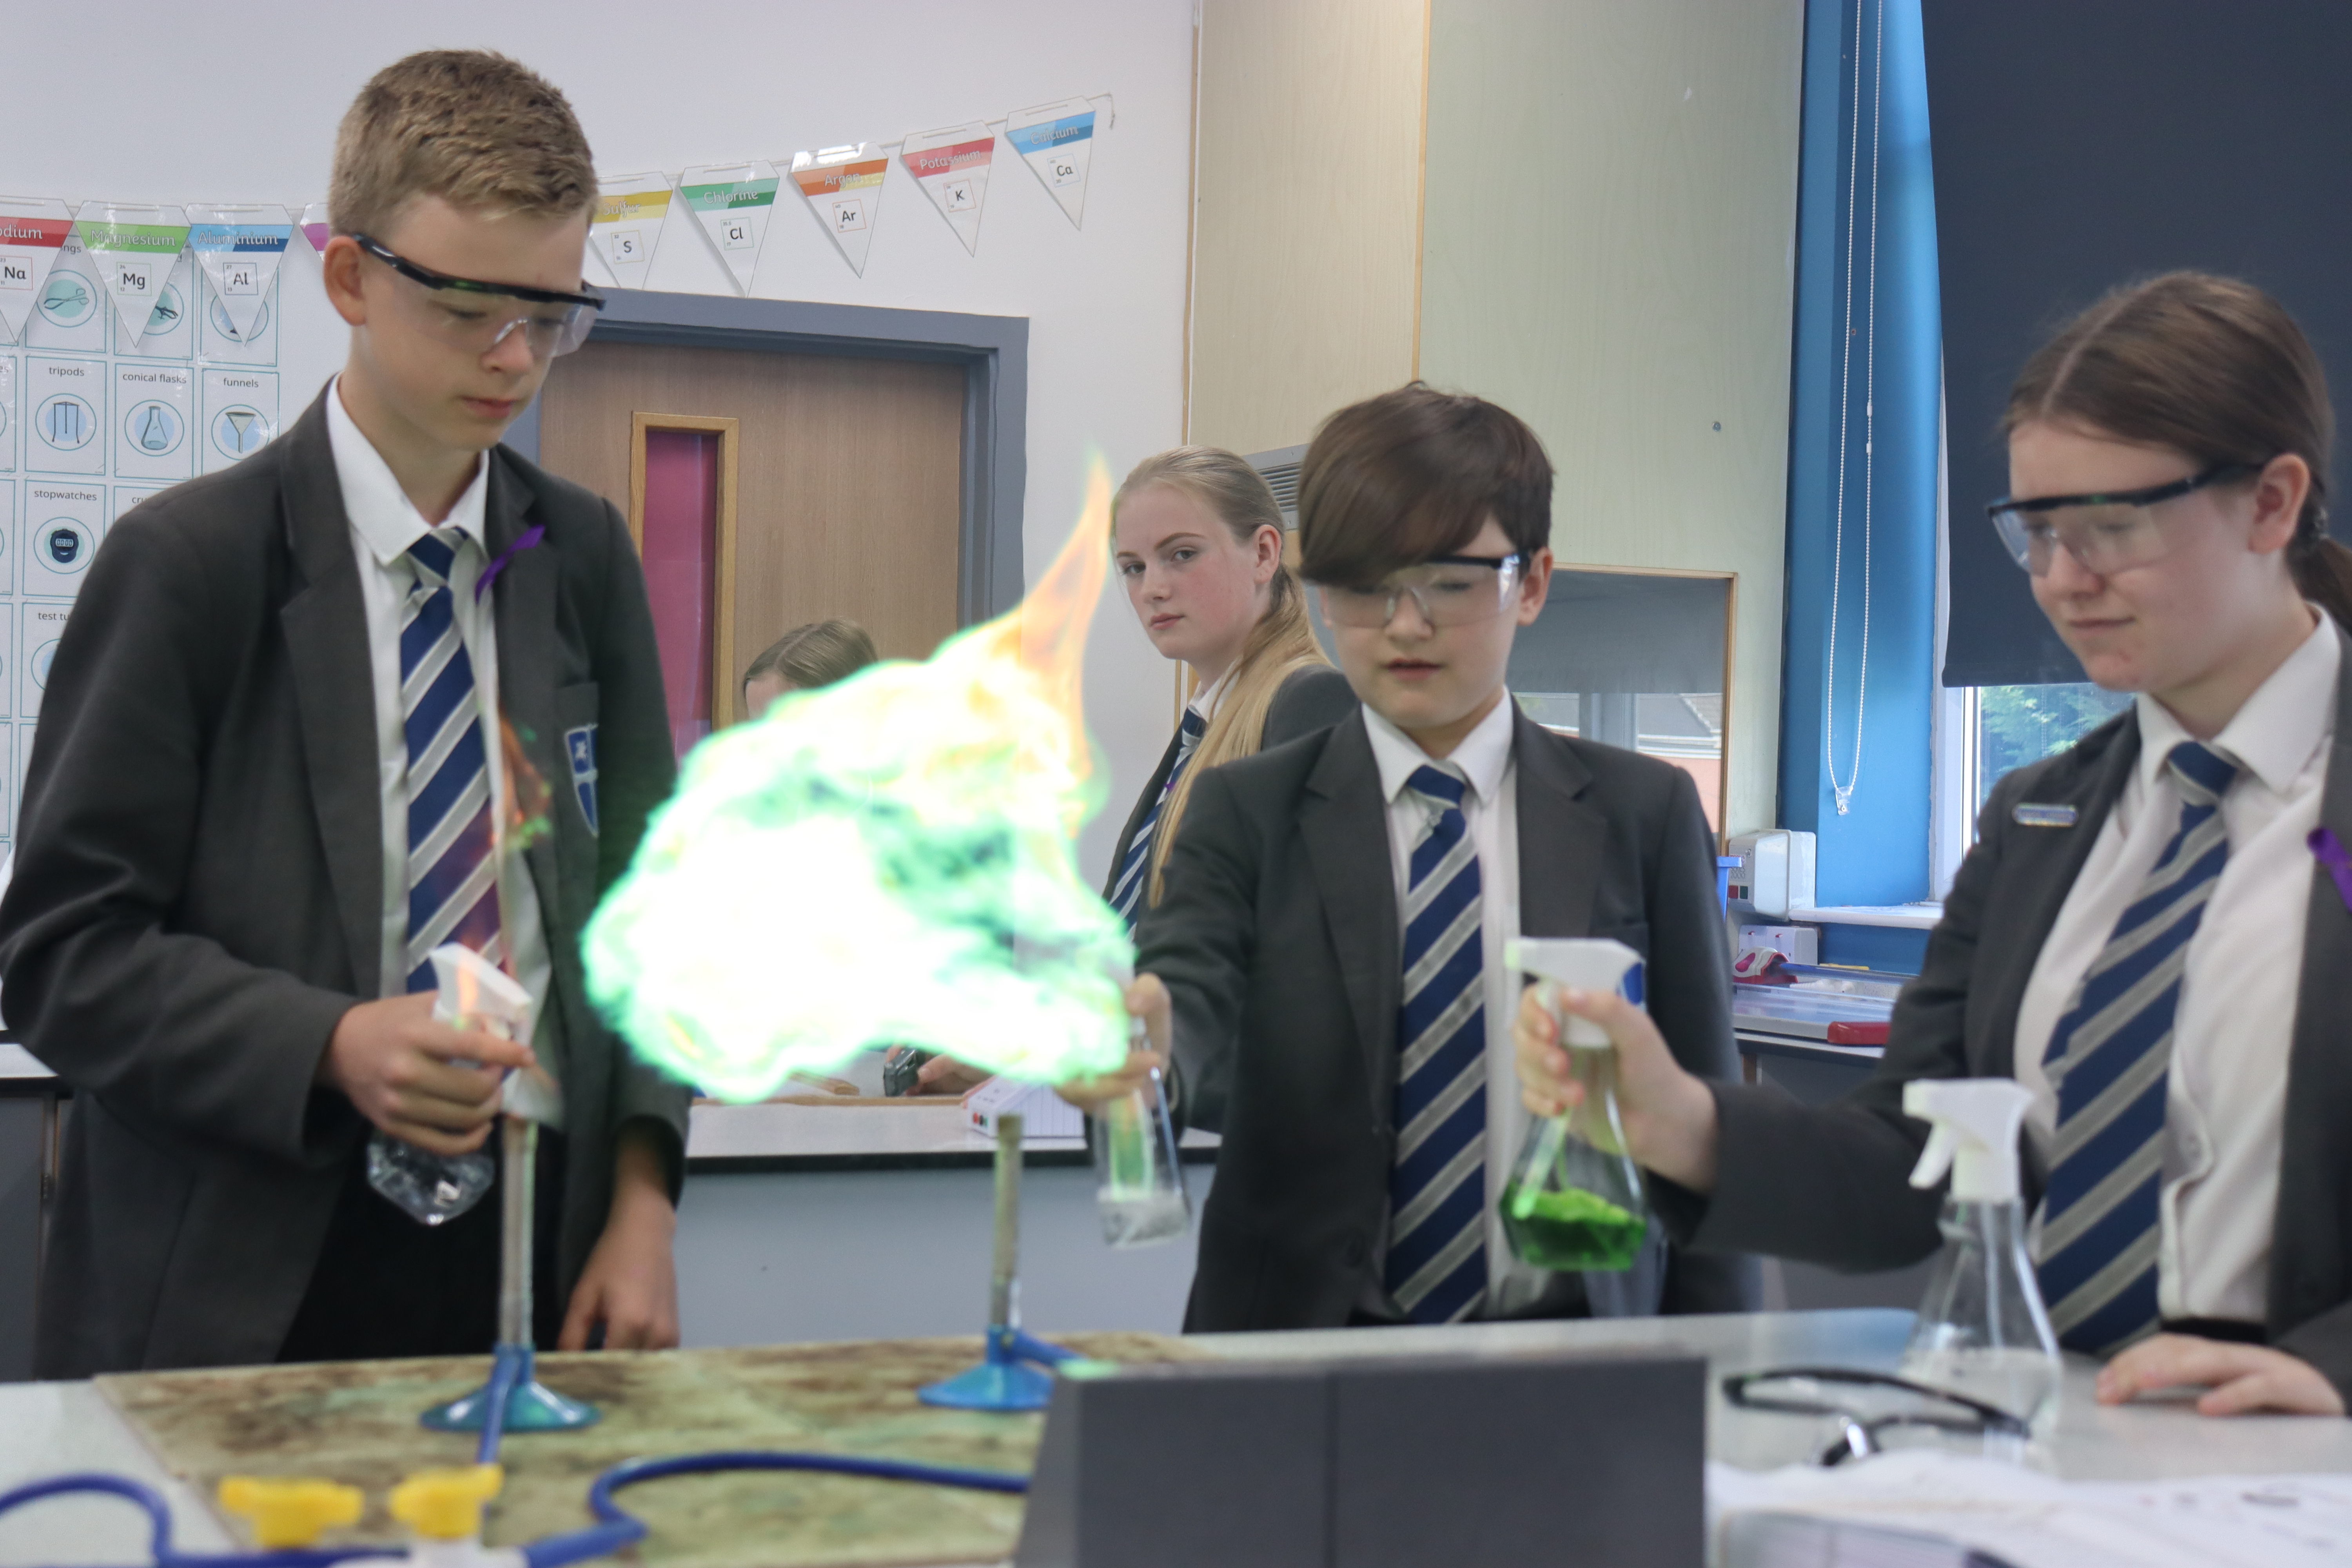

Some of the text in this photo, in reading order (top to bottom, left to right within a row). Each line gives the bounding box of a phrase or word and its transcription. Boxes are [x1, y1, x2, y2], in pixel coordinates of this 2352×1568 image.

[1031, 126, 1079, 145] Calcium
[920, 151, 982, 170] Potassium
[1057, 165, 1073, 176] Ca
[825, 173, 862, 188] Argon
[704, 189, 758, 204] Chlorine
[955, 190, 965, 201] K
[603, 201, 641, 218] Sulfur
[842, 210, 856, 222] Ar
[91, 229, 176, 248] Magnesium
[198, 230, 278, 245] Aluminium
[730, 227, 744, 240] Cl
[624, 241, 632, 253] S
[4, 266, 26, 279] Na
[233, 272, 249, 285] Al
[123, 273, 145, 290] Mg
[49, 367, 85, 377] tripods
[123, 373, 187, 383] conical flasks
[223, 377, 259, 388] funnels
[34, 490, 97, 501] stopwatches
